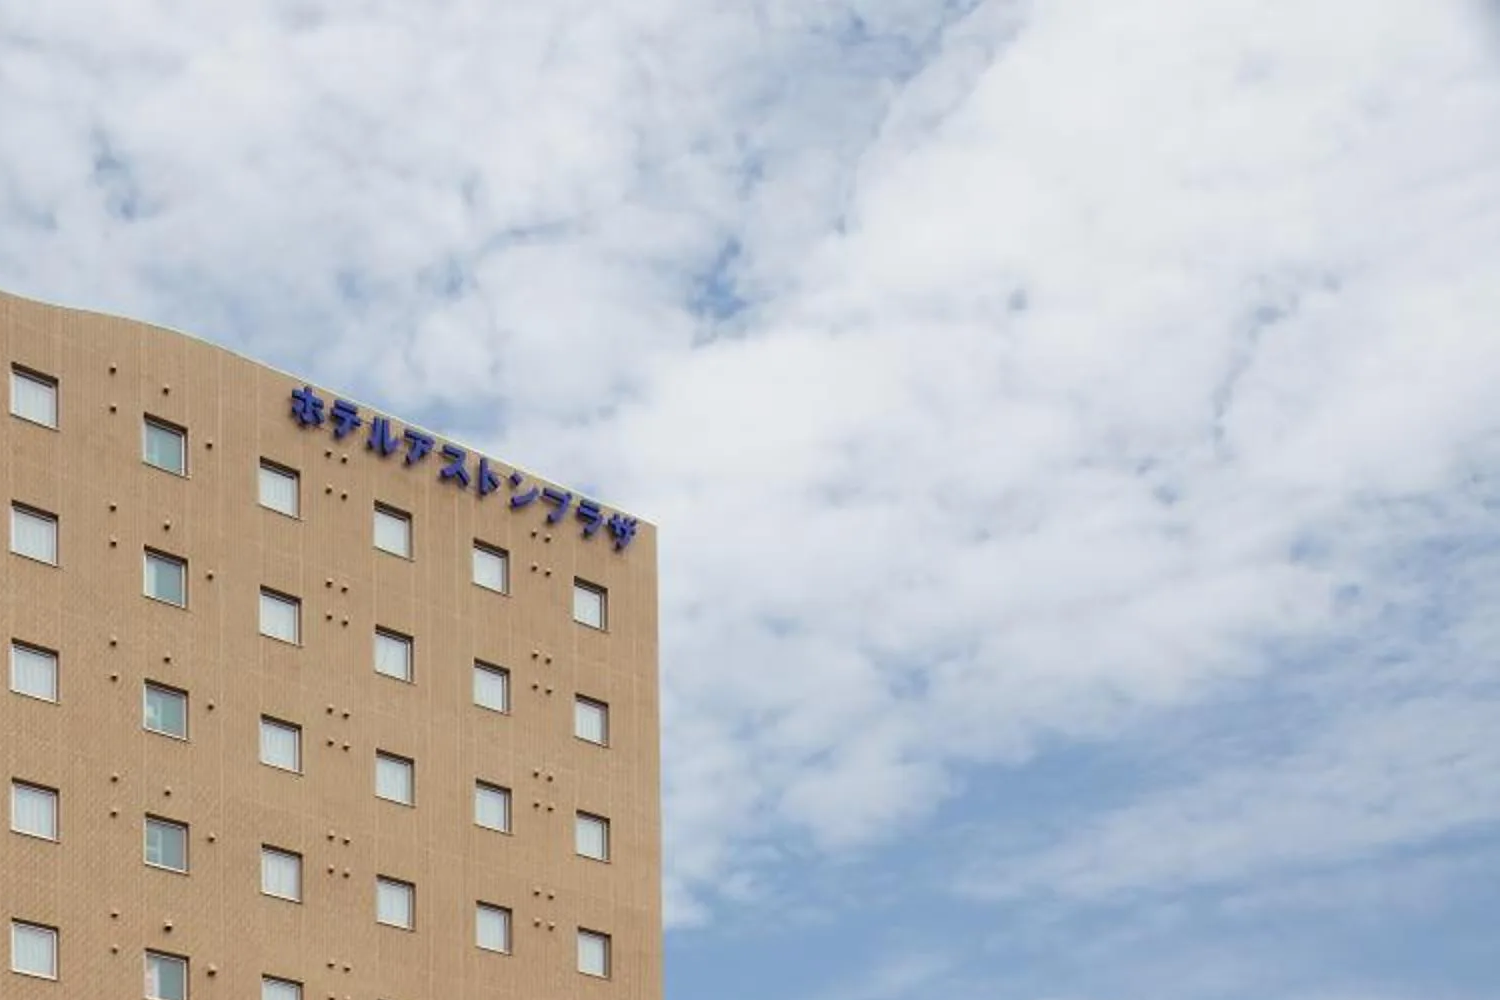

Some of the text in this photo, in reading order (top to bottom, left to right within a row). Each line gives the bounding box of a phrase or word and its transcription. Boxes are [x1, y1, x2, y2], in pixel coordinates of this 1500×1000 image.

[290, 386, 638, 553] ホテルアストンプラザ
